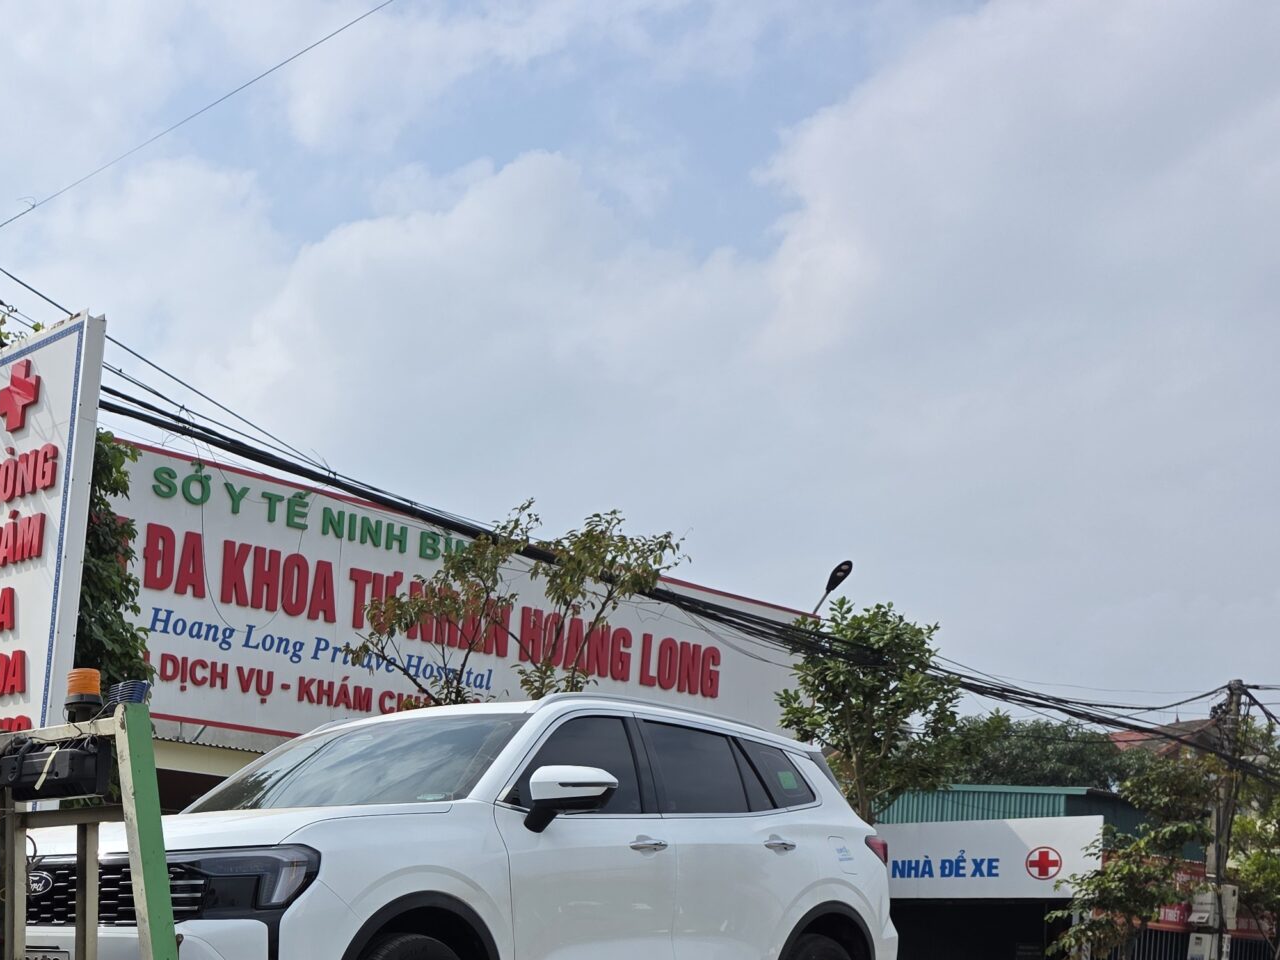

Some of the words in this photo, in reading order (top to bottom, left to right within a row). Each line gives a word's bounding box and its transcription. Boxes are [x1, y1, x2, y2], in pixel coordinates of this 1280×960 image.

[151, 460, 212, 505] SỞ
[224, 482, 250, 514] Y
[261, 489, 313, 530] TẾ
[321, 506, 408, 553] NINH
[143, 522, 206, 599] ĐA
[220, 540, 336, 623] KHOA
[639, 632, 721, 699] LONG
[149, 607, 236, 650] Hoang
[241, 624, 305, 664] Long
[159, 652, 229, 692] DỊCH
[236, 665, 274, 704] VỤ
[297, 675, 373, 713] KHÁM
[891, 854, 934, 879] NHÀ
[939, 848, 967, 878] ĐỂ
[970, 857, 1000, 878] XE
